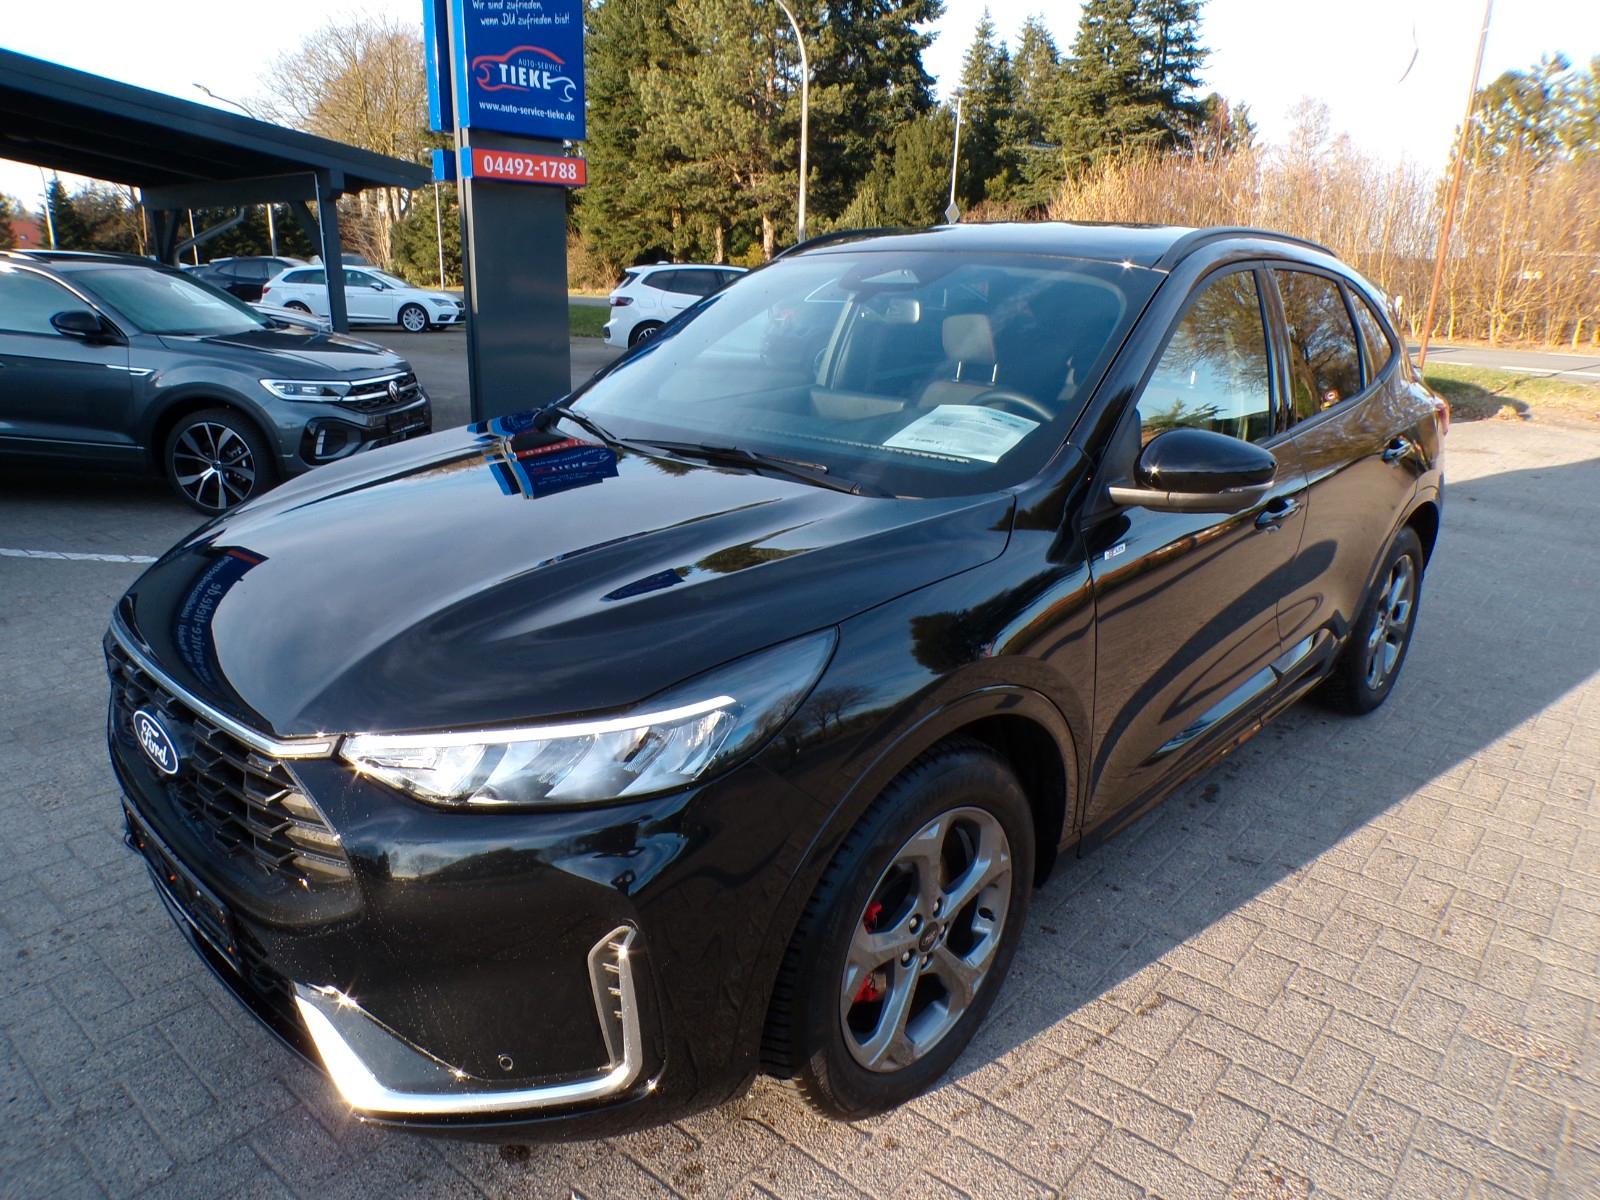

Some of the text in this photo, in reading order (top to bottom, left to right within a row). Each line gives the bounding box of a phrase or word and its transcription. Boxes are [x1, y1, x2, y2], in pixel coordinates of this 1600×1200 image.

[472, 0, 485, 10] Wir
[488, 0, 503, 10] sind
[480, 17, 499, 26] wenn
[501, 12, 516, 26] DU
[518, 13, 552, 31] zufrieden
[518, 57, 562, 73] AUTO-SERVICE
[498, 63, 551, 90] TIEKE
[479, 101, 576, 122] www.auto-service-tieke.de
[483, 155, 577, 180] 04492-1788
[140, 718, 168, 766] Ford
